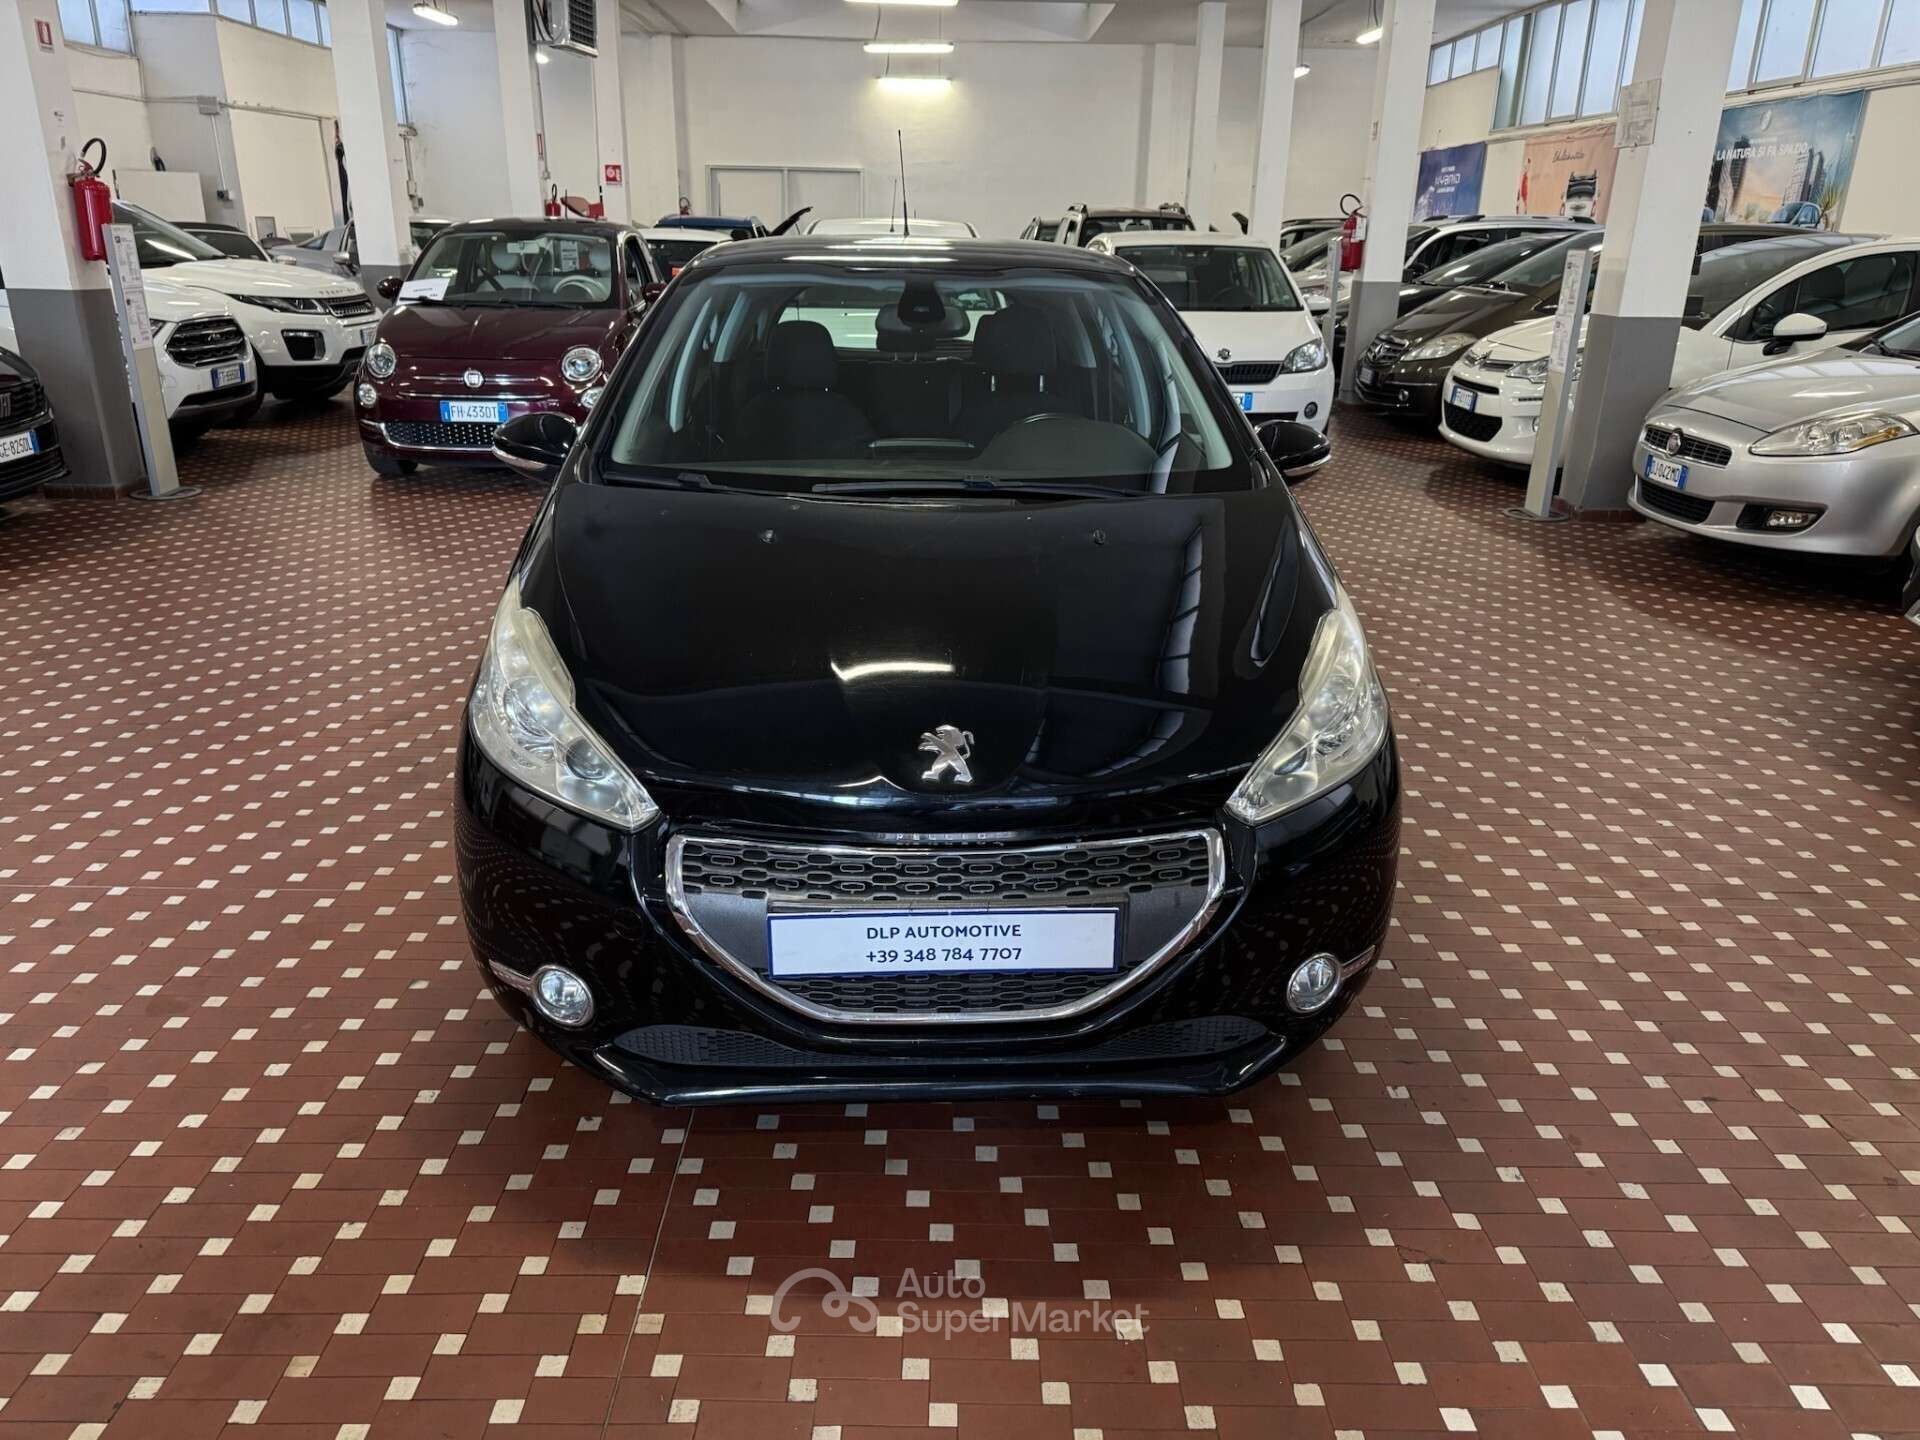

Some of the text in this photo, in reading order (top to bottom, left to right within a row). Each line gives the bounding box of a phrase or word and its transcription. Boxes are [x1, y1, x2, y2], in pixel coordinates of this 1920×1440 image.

[867, 924, 1022, 940] DLP AUTOMOTIVE
[866, 947, 1022, 963] +39 348 784 7707
